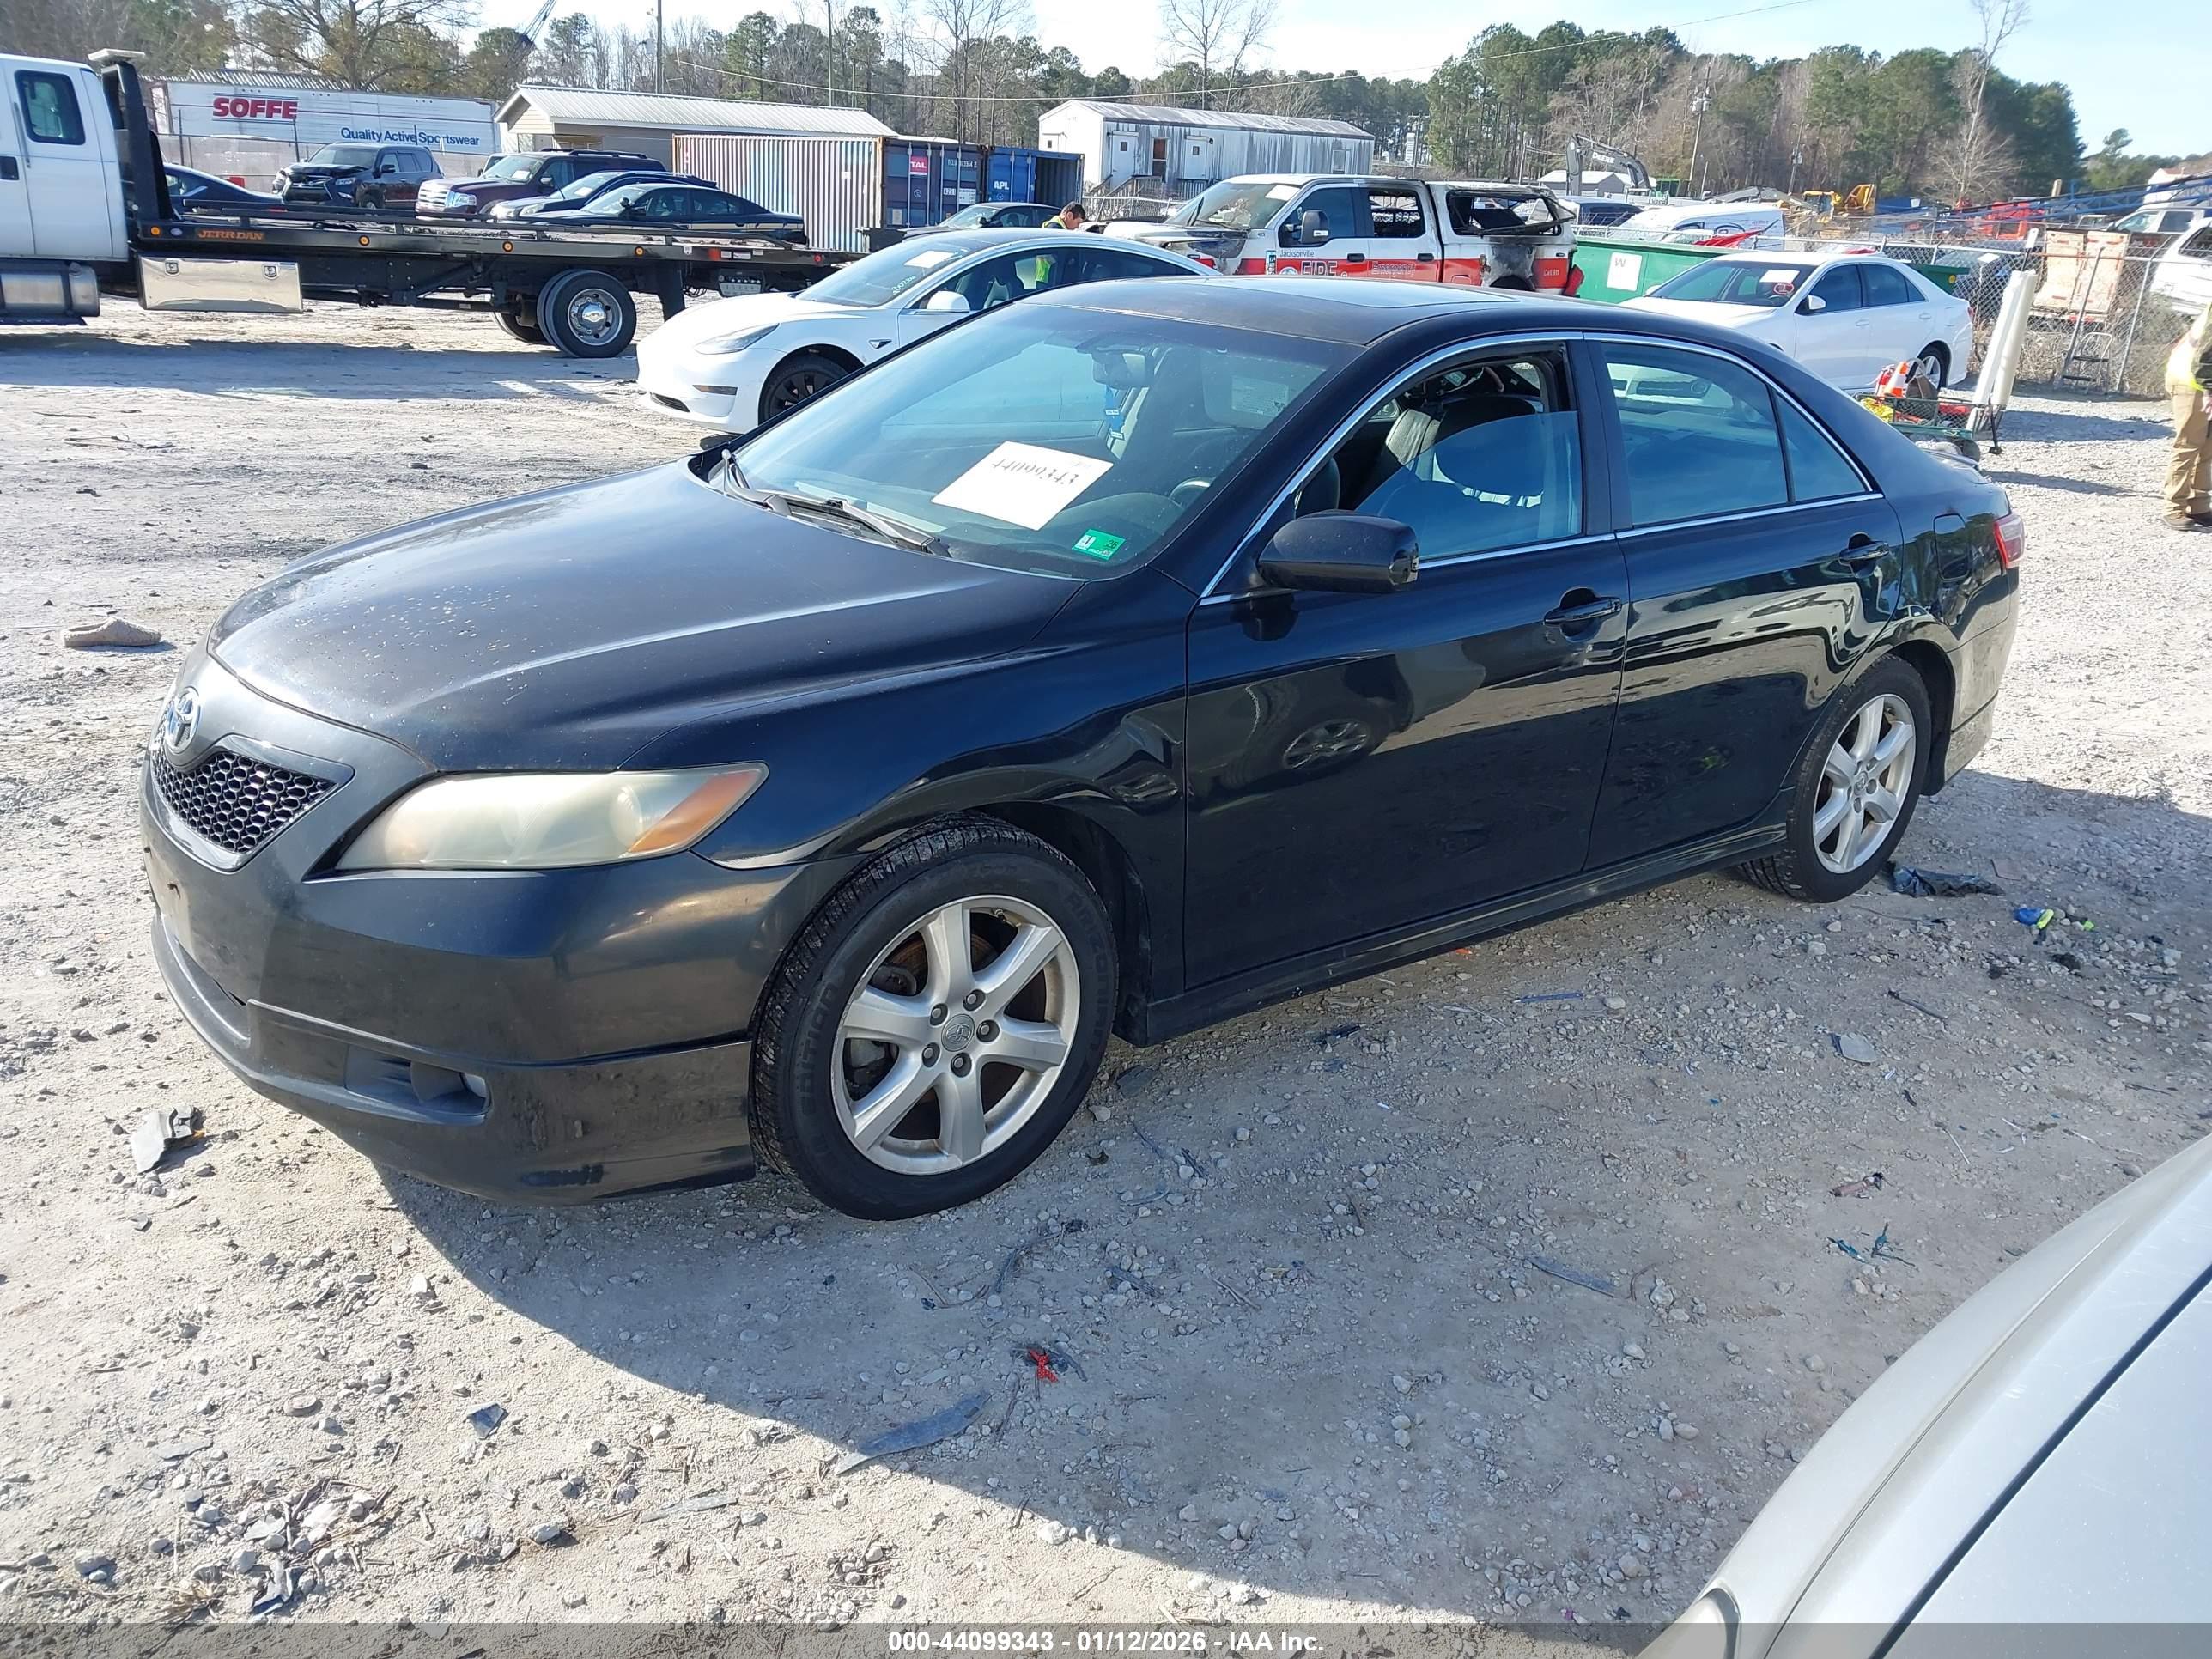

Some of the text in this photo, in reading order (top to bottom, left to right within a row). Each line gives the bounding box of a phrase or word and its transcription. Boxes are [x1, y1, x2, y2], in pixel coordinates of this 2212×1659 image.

[213, 97, 298, 119] SOFFE
[340, 127, 382, 143] Quality
[384, 130, 416, 143] Active
[1592, 151, 1615, 164] DEERE
[994, 181, 1009, 190] APL
[1279, 249, 1315, 258] Jacksonville
[1371, 260, 1416, 278] Emergency
[992, 459, 1079, 485] 44099343
